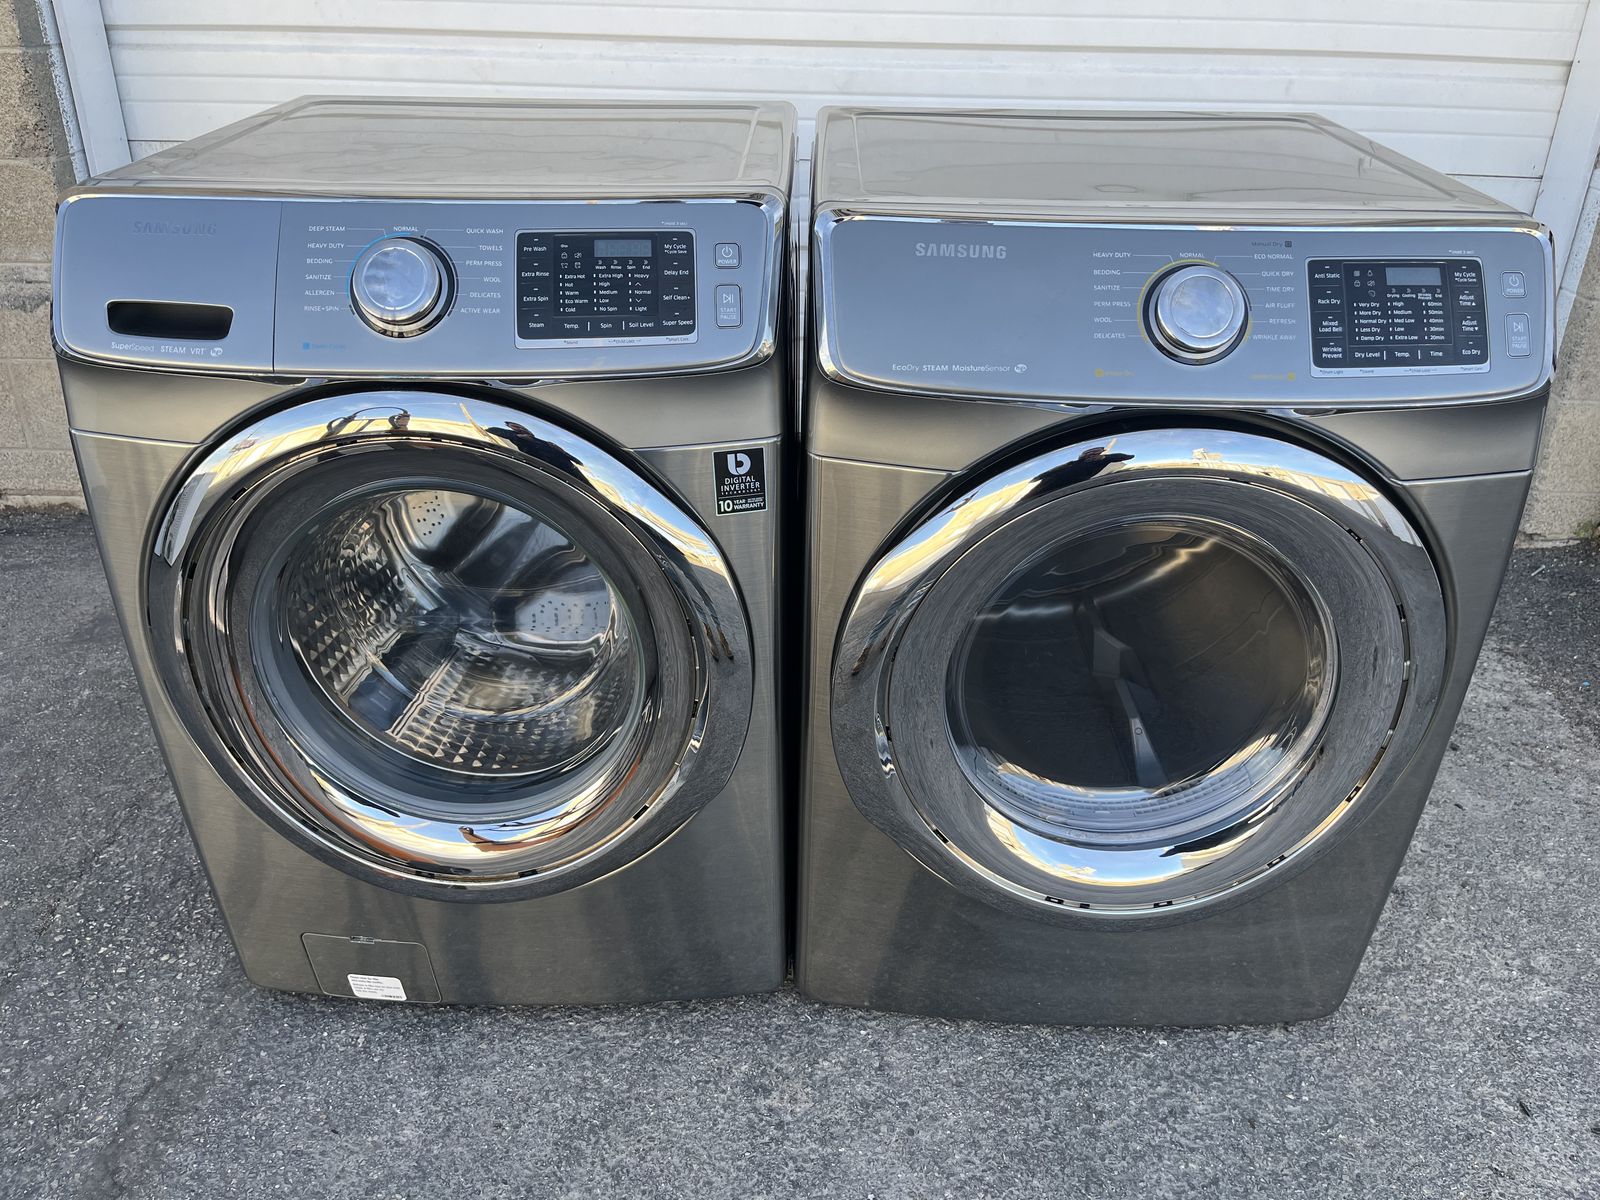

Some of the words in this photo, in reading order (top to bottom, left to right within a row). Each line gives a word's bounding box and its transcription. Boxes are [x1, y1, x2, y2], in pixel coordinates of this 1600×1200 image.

[132, 221, 217, 235] SAMSUNG
[915, 242, 1007, 259] SAMSUNG
[111, 342, 155, 352] SuperSpeed
[160, 345, 186, 354] STEAM
[190, 347, 205, 355] VRT
[892, 364, 920, 372] EcoDry
[922, 364, 949, 372] STEAM
[952, 364, 1011, 372] MoistureSensor
[724, 475, 756, 485] DIGITAL
[721, 481, 761, 492] INVERTER
[718, 499, 733, 512] 10
[734, 502, 764, 510] WARRANTY
